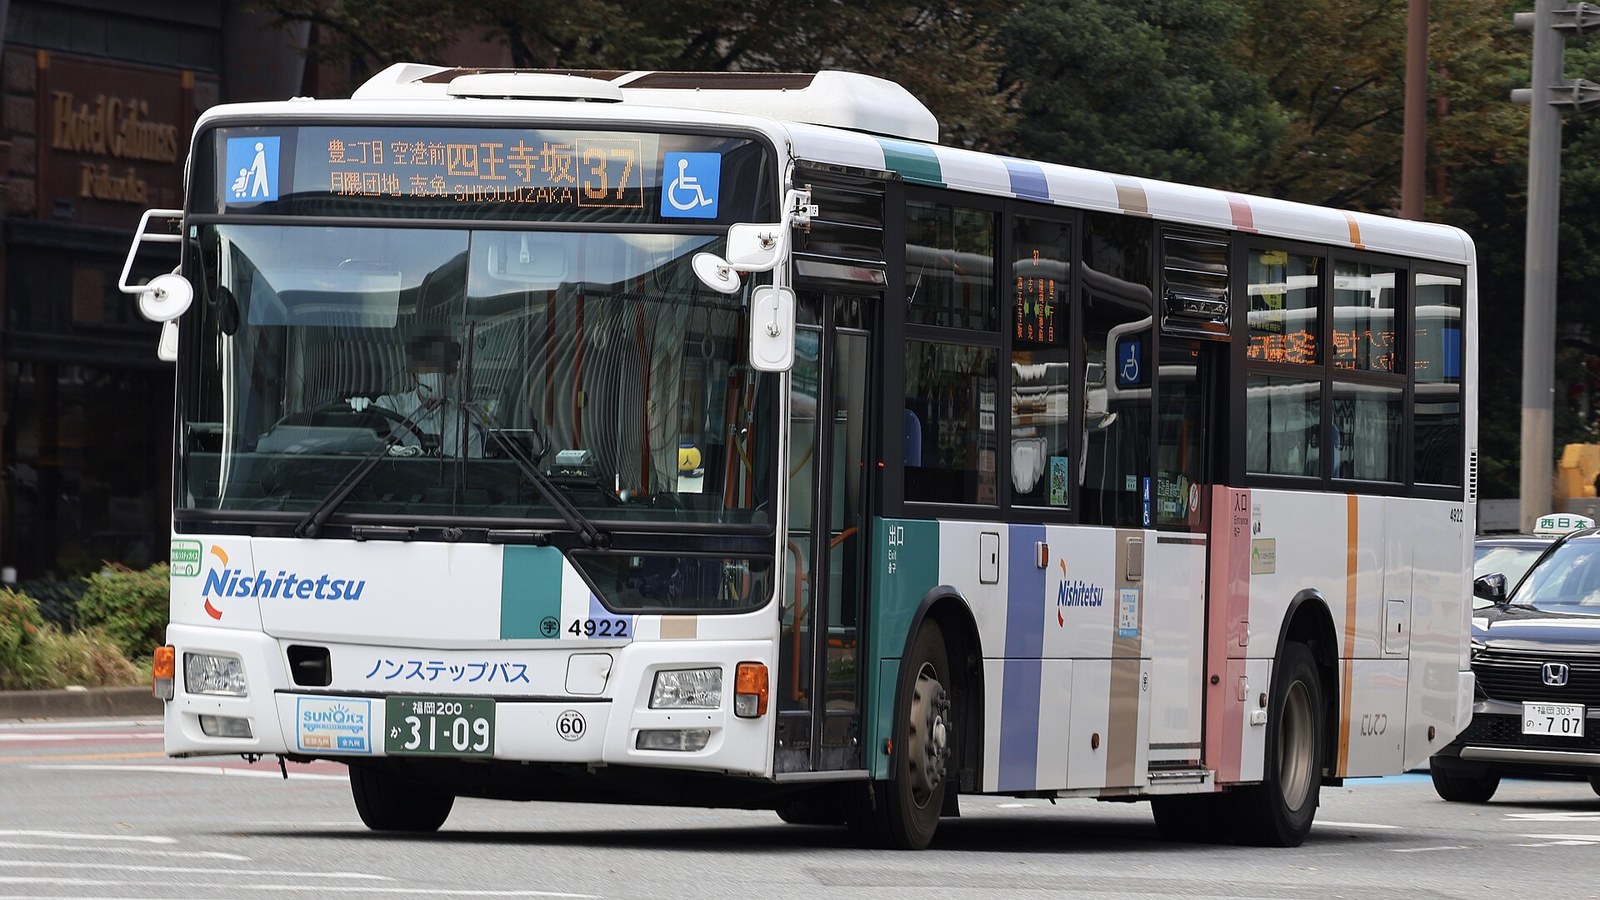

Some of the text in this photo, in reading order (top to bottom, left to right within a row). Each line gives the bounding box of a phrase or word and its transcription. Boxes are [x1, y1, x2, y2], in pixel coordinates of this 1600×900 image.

[51, 90, 107, 154] Hotel
[328, 139, 446, 166] 豊二丁目 空港前
[446, 140, 576, 183] 四王寺坂
[329, 171, 448, 198] 月隈団地 志免
[583, 148, 635, 200] 37
[1234, 493, 1247, 512] 入口
[1450, 508, 1464, 523] 4922
[888, 524, 904, 547] 出口
[1541, 518, 1588, 530] 西日本
[202, 567, 366, 601] Nishitetsu
[1057, 579, 1104, 607] Nishitetsu
[568, 619, 628, 637] 4922
[365, 659, 530, 684] ノンステップバス
[404, 716, 490, 752] 31-09
[560, 717, 583, 734] 60
